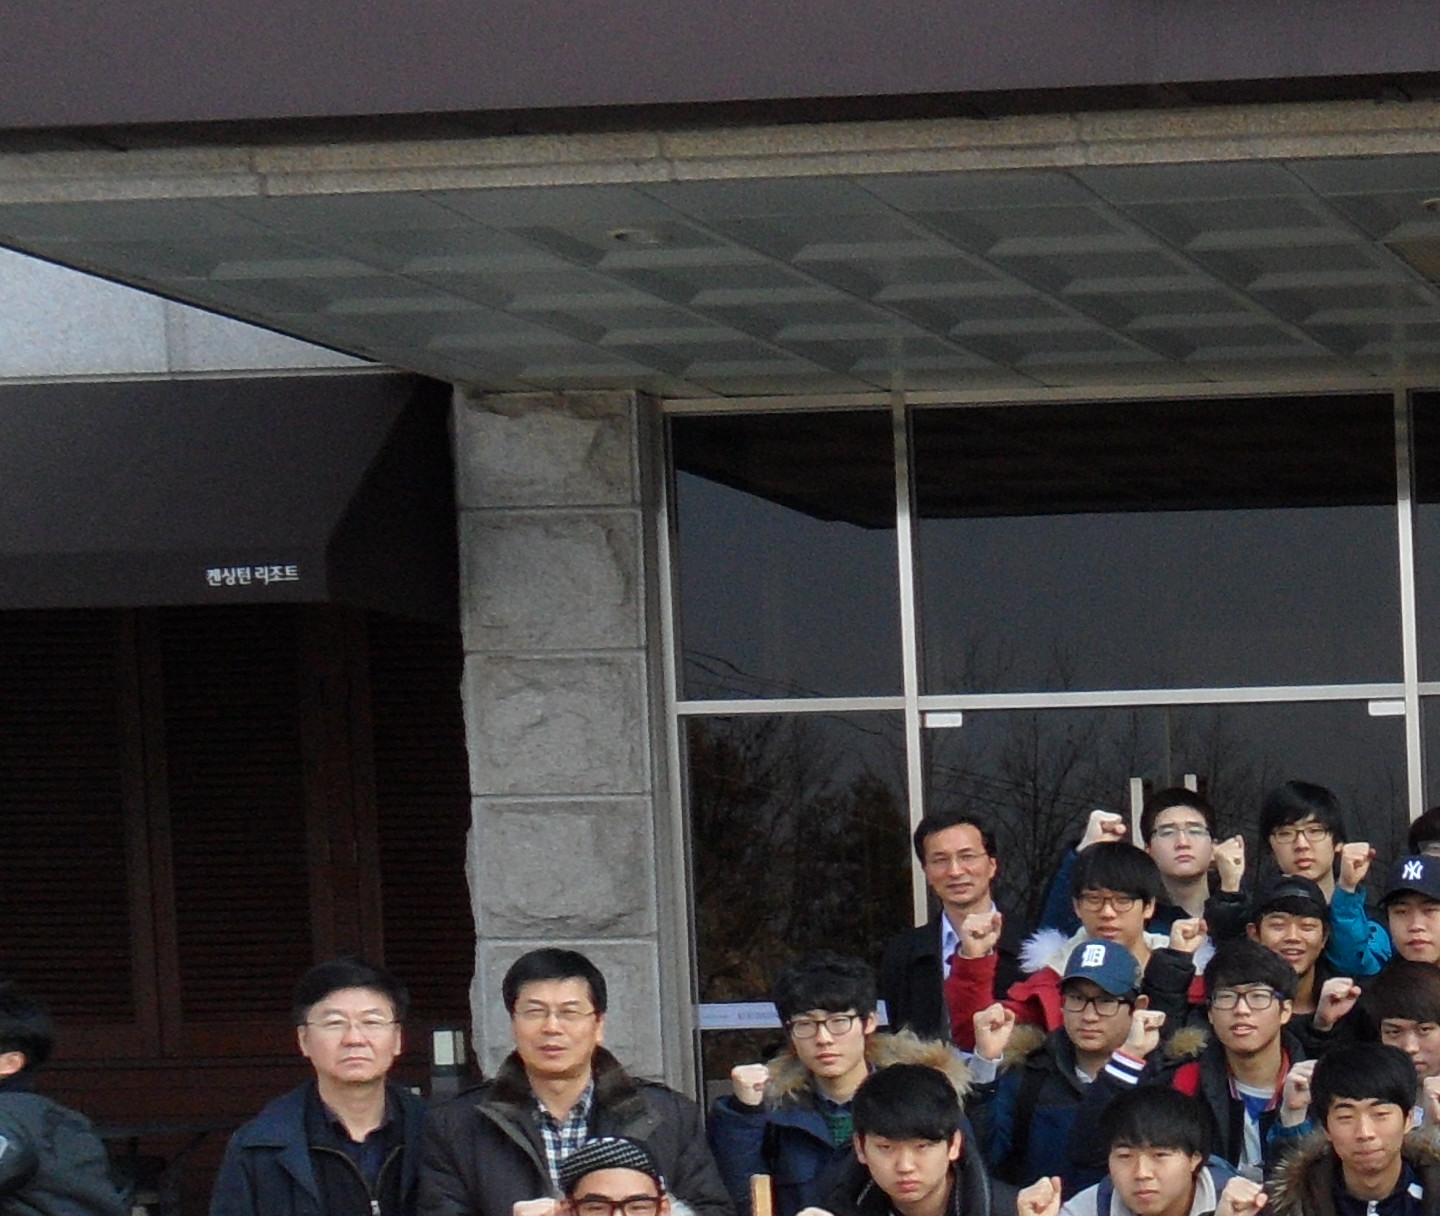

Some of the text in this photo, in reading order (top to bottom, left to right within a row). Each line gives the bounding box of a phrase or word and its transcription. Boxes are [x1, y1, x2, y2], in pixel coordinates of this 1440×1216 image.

[205, 565, 300, 587] 켄싱턴 리조트
[1402, 860, 1424, 880] NY
